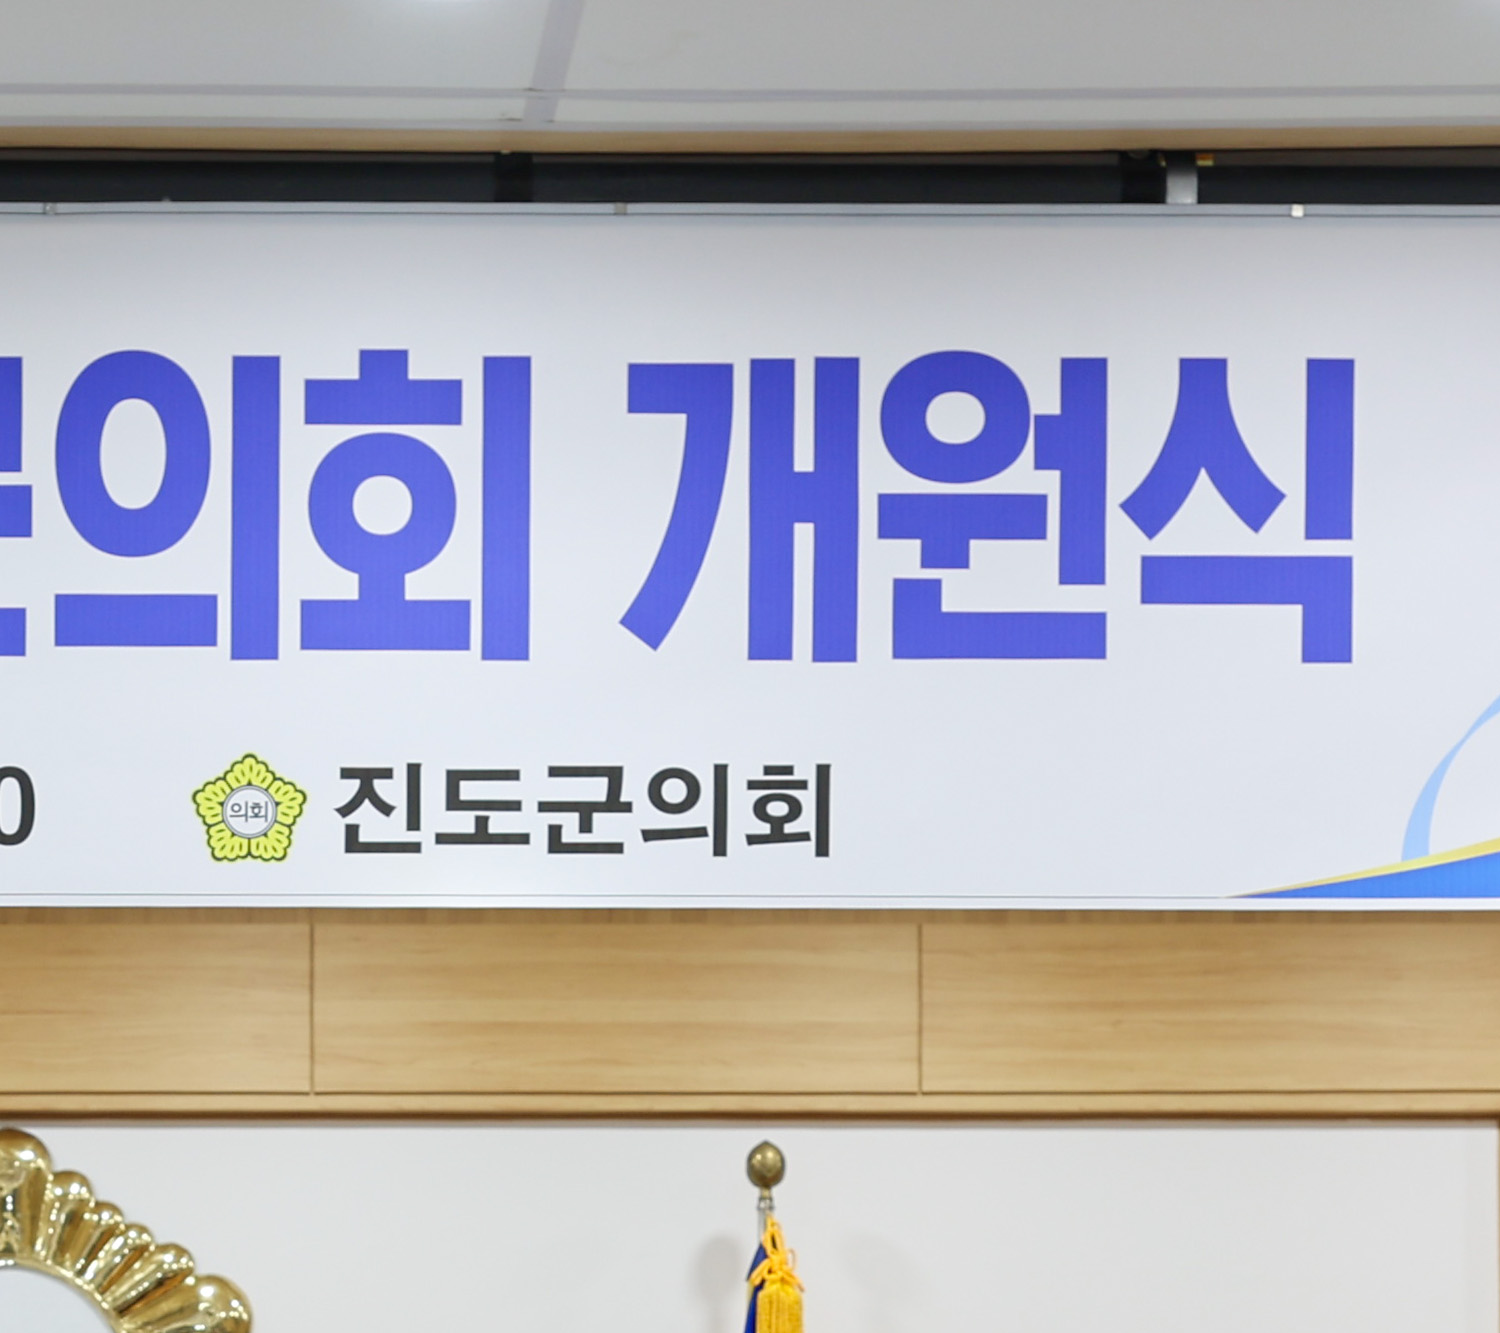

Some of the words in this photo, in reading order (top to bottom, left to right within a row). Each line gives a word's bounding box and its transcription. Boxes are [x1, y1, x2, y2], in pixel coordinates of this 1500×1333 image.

[619, 348, 1356, 666] 개원식
[229, 800, 269, 823] 의회
[333, 759, 836, 860] 진도군의회
